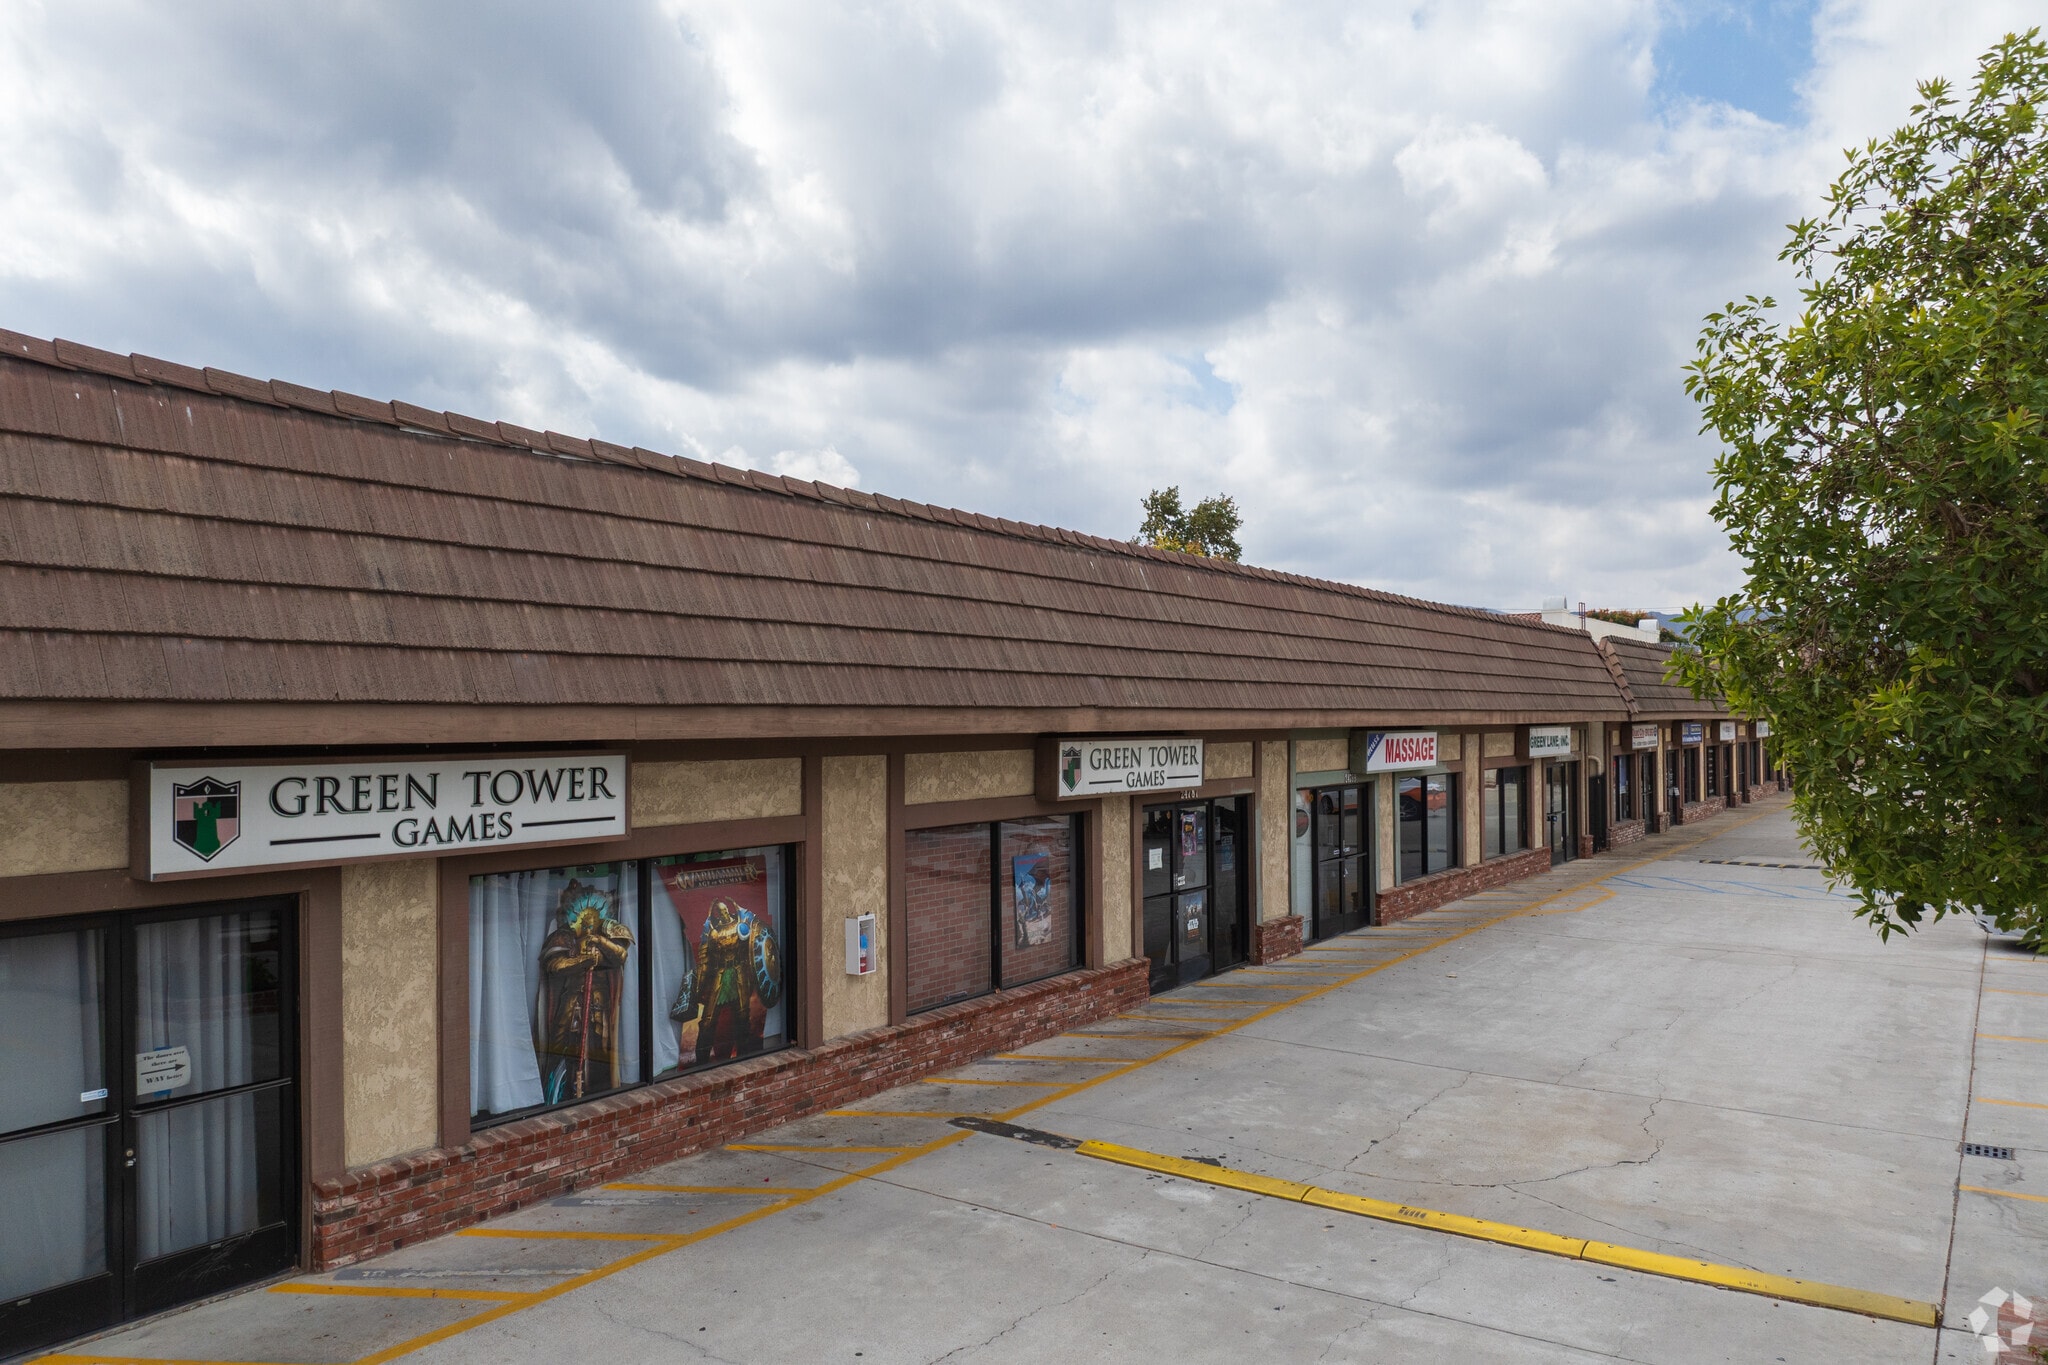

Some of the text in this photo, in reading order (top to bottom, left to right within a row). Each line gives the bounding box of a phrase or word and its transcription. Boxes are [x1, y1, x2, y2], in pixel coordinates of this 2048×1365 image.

[1385, 737, 1434, 763] MASSAGE
[1530, 735, 1547, 749] GREEN
[1090, 745, 1199, 771] GREEN TOWER
[1126, 770, 1165, 788] GAMES
[269, 766, 616, 818] GREEN TOWER
[392, 811, 513, 848] GAMES
[676, 864, 758, 889] WARHAMMER
[146, 1075, 165, 1084] WAY
